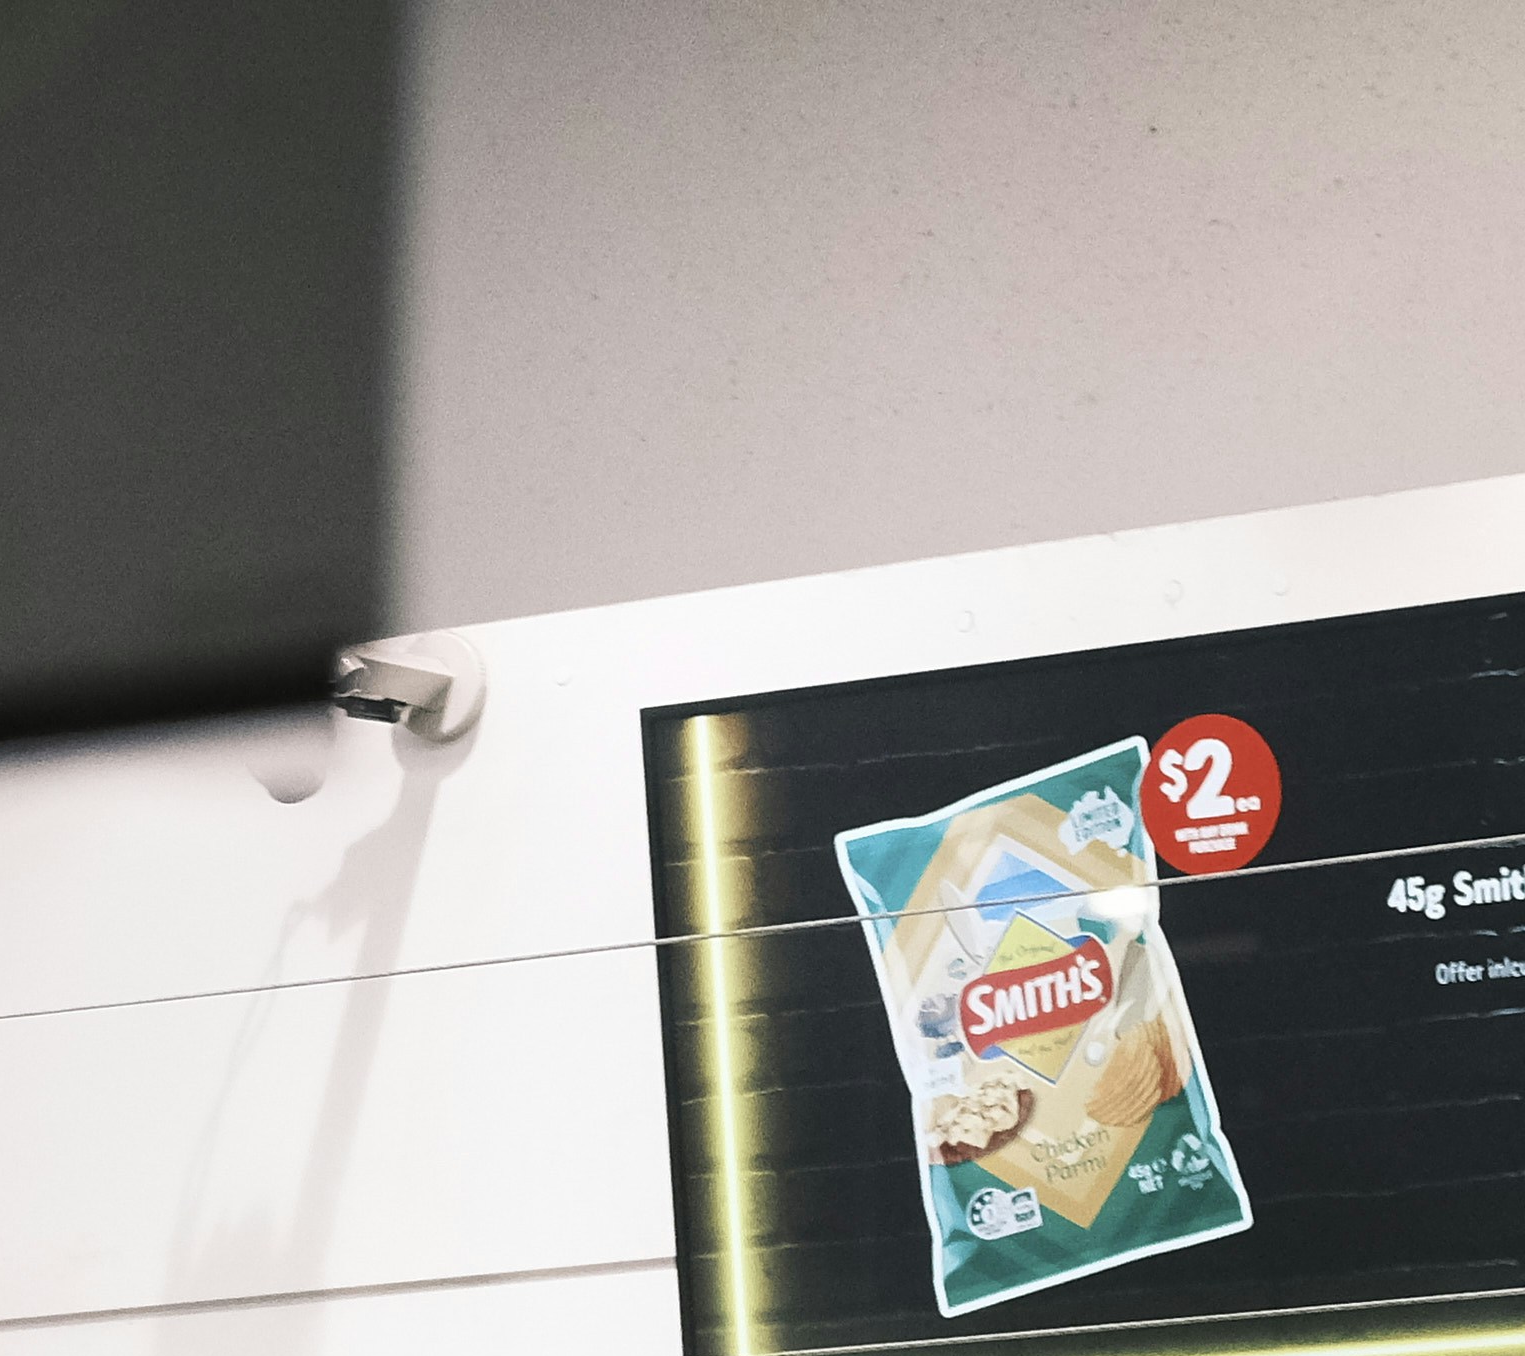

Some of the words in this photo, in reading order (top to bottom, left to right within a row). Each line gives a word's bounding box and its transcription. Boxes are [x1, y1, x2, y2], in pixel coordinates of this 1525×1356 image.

[1387, 876, 1446, 920] 45g
[1435, 960, 1484, 985] Offer
[966, 954, 1103, 1035] SMITH'S
[1030, 1127, 1111, 1165] Chicken
[1045, 1155, 1107, 1183] Parmi
